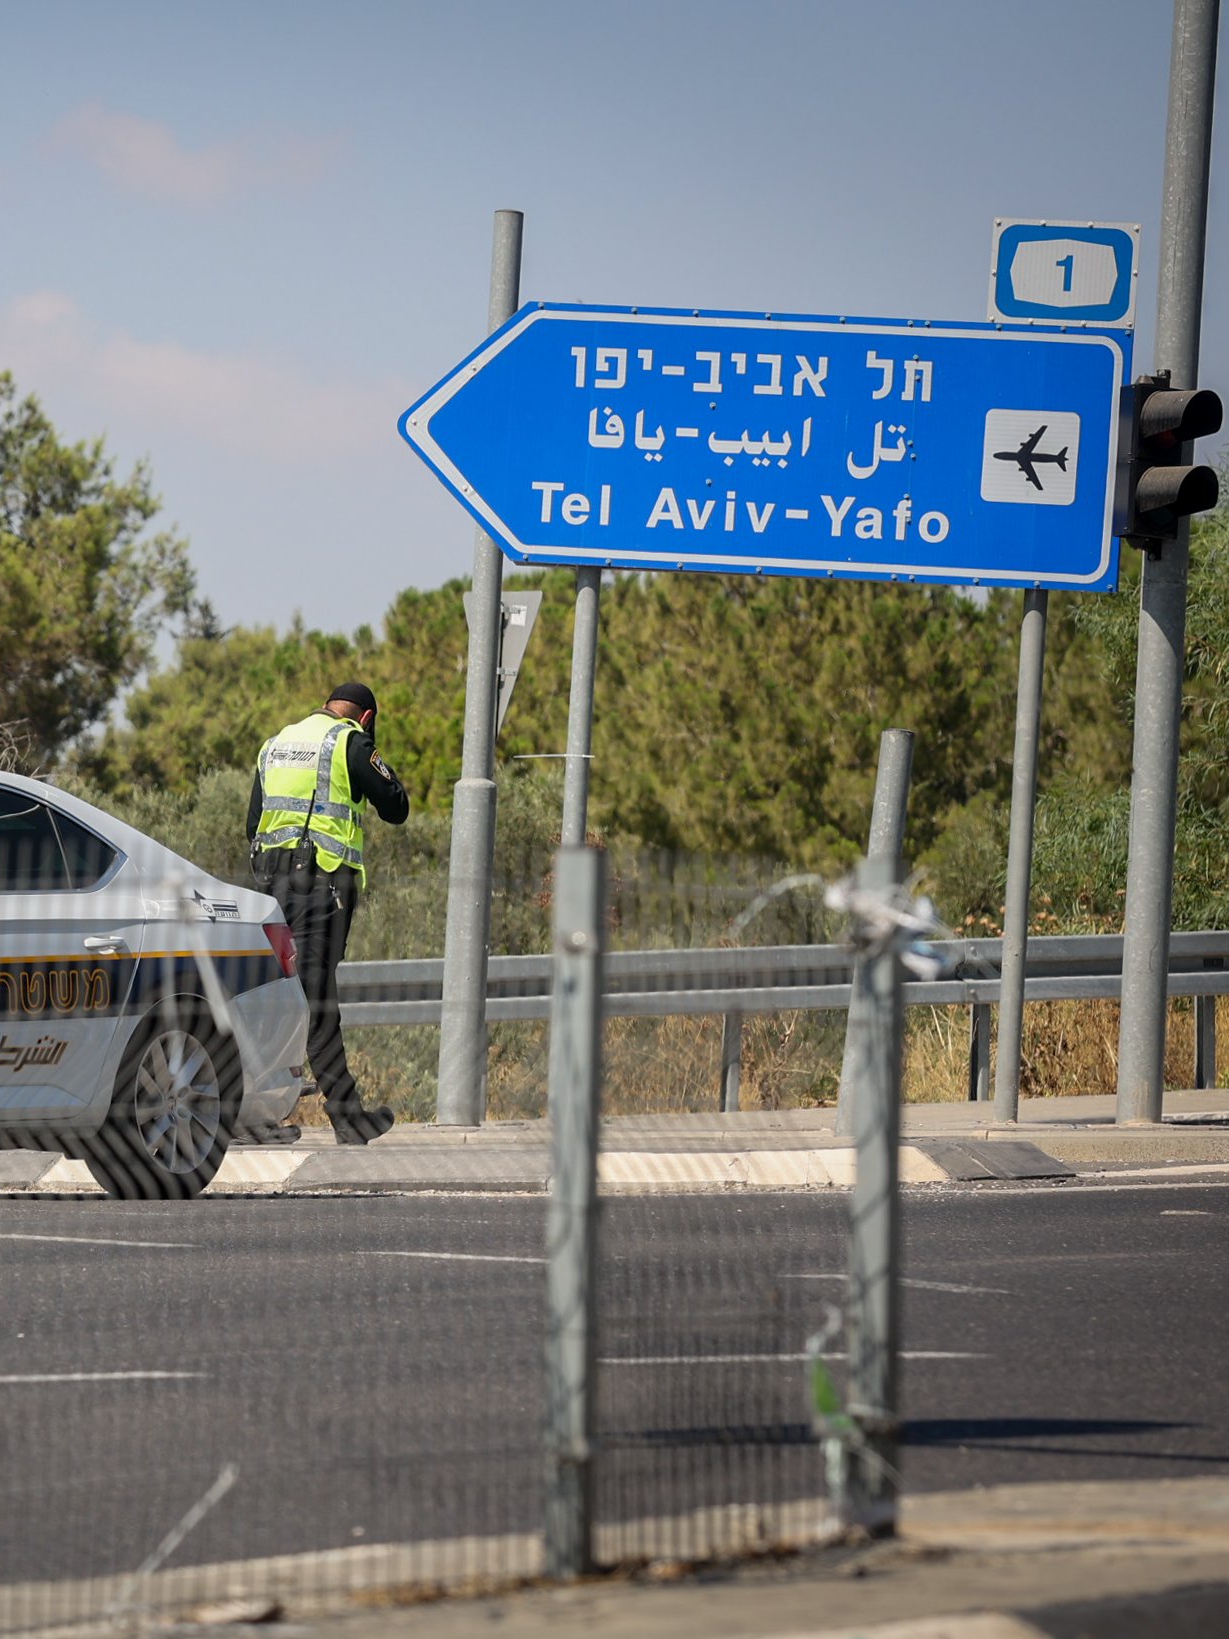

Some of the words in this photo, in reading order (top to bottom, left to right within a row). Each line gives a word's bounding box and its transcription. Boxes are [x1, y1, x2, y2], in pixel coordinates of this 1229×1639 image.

[1055, 254, 1074, 292] 1
[571, 345, 829, 398] אביב-יפו
[866, 350, 933, 402] תל
[846, 419, 907, 480] تل
[531, 481, 611, 527] Tel
[645, 486, 950, 544] Aviv-Yafo
